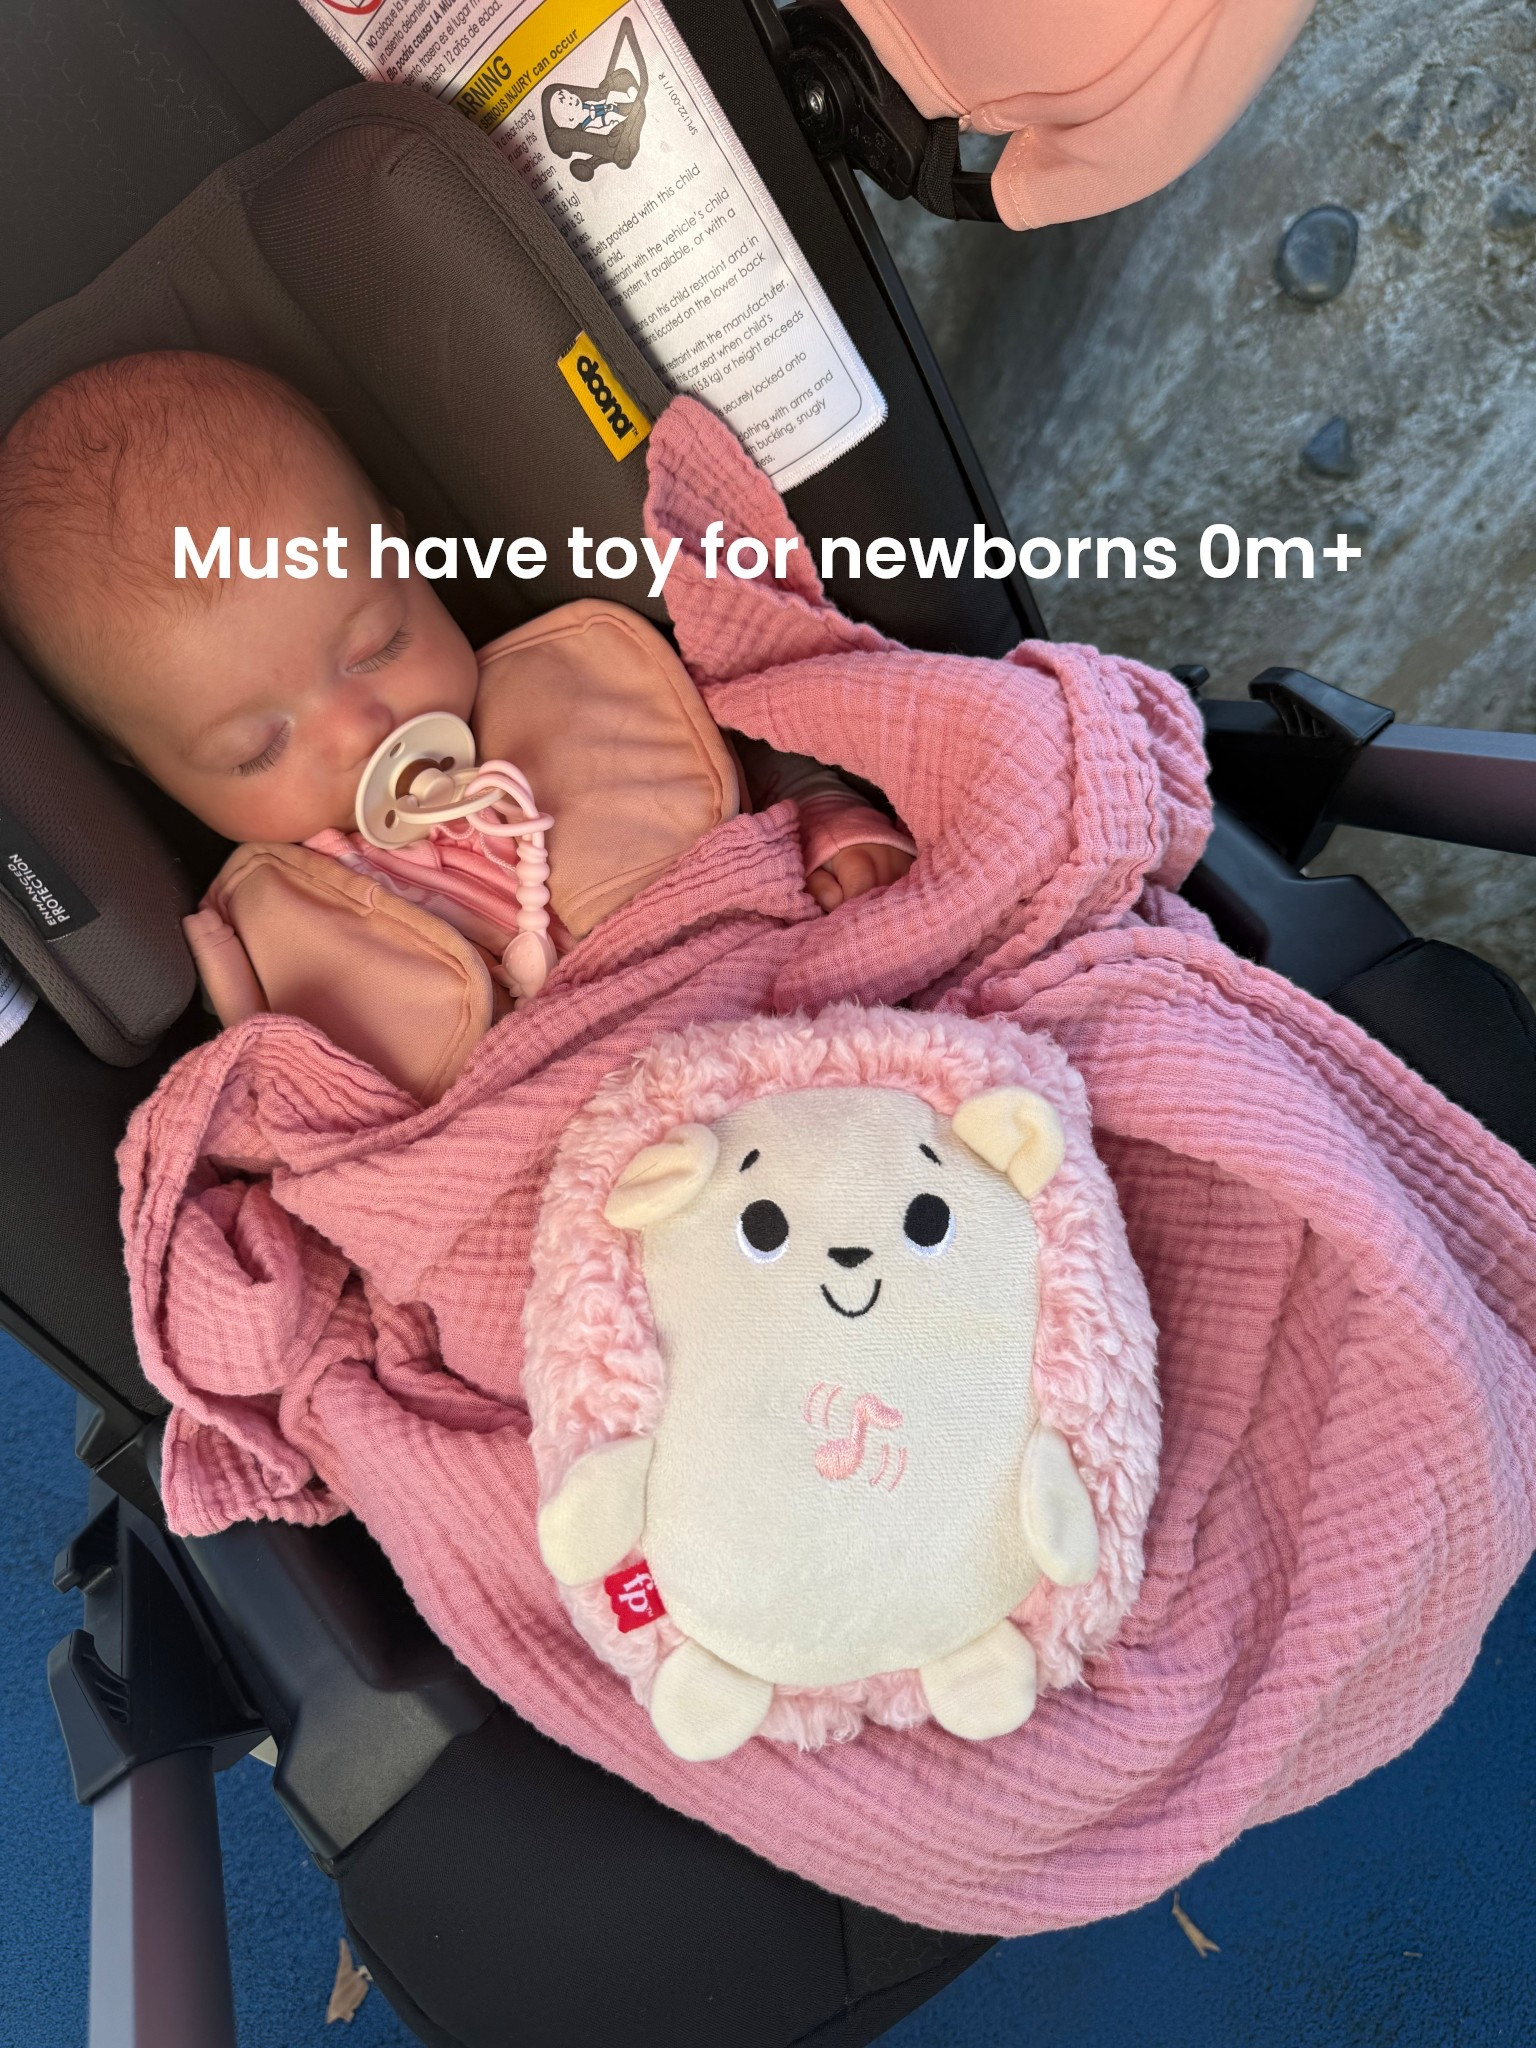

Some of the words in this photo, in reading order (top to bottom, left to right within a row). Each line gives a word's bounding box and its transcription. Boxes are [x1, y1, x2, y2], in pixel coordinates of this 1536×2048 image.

[365, 34, 378, 51] NO
[375, 8, 398, 40] coloque
[392, 0, 404, 14] la
[386, 66, 399, 82] Ello
[395, 44, 415, 73] podría
[412, 20, 434, 49] causar
[429, 9, 443, 26] LA
[426, 62, 447, 86] hasta
[443, 50, 456, 66] 12
[452, 34, 471, 57] años
[467, 23, 480, 39] de
[478, 0, 503, 27] edad.
[438, 31, 449, 45] es
[446, 20, 456, 36] el
[450, 2, 472, 29] lugar
[377, 52, 388, 66] un
[384, 30, 405, 57] asiento
[418, 41, 441, 68] trasero
[480, 98, 509, 130] SERIOUS
[504, 70, 532, 105] INJURY
[532, 56, 550, 77] can
[549, 28, 578, 60] occur
[658, 72, 667, 81] R
[456, 55, 512, 121] ARNING
[504, 108, 536, 140] rear-facing
[511, 141, 530, 160] using
[524, 130, 538, 147] this
[520, 152, 546, 175] vehicle.
[530, 165, 557, 191] children
[556, 181, 564, 191] 4
[564, 191, 581, 208] kg)
[573, 211, 586, 225] 32
[589, 240, 608, 257] belts
[605, 212, 640, 249] provided
[637, 200, 659, 219] with
[656, 186, 676, 204] this
[675, 162, 701, 190] child
[593, 262, 607, 279] your
[606, 248, 626, 268] child.
[607, 263, 634, 288] restraint
[631, 253, 649, 270] with
[646, 243, 663, 258] the
[661, 210, 705, 246] vehicle's
[704, 186, 730, 214] child
[622, 279, 647, 300] system,
[643, 270, 652, 283] if
[651, 244, 694, 278] available,
[693, 232, 705, 246] or
[704, 215, 728, 236] with
[727, 207, 736, 219] a
[647, 312, 659, 324] on
[655, 302, 671, 317] this
[669, 286, 691, 308] child
[689, 259, 727, 294] restraint
[727, 240, 749, 265] and
[748, 235, 760, 248] in
[653, 312, 684, 339] located
[683, 306, 696, 320] on
[694, 295, 712, 311] the
[709, 274, 739, 300] lower
[737, 251, 766, 278] back
[666, 348, 692, 371] restraint
[690, 339, 709, 355] with
[706, 330, 723, 345] the
[722, 279, 789, 335] manufacturer.
[675, 371, 689, 384] this
[687, 364, 700, 378] car
[699, 352, 718, 371] seat
[716, 337, 743, 358] when
[743, 313, 774, 340] child's
[691, 377, 710, 398] (15.8
[707, 368, 724, 384] kg)
[722, 363, 732, 375] or
[730, 341, 763, 369] height
[763, 309, 804, 347] exceeds
[577, 355, 634, 440] doona
[722, 389, 754, 415] securely
[751, 366, 786, 395] locked
[784, 351, 807, 373] onto
[735, 419, 770, 445] clothing
[768, 406, 790, 423] with
[789, 388, 814, 410] arms
[813, 369, 834, 392] and
[755, 422, 797, 451] buckling,
[796, 397, 826, 425] snugly
[8, 863, 57, 927] ENHANCED
[9, 853, 71, 923] PROTECTION
